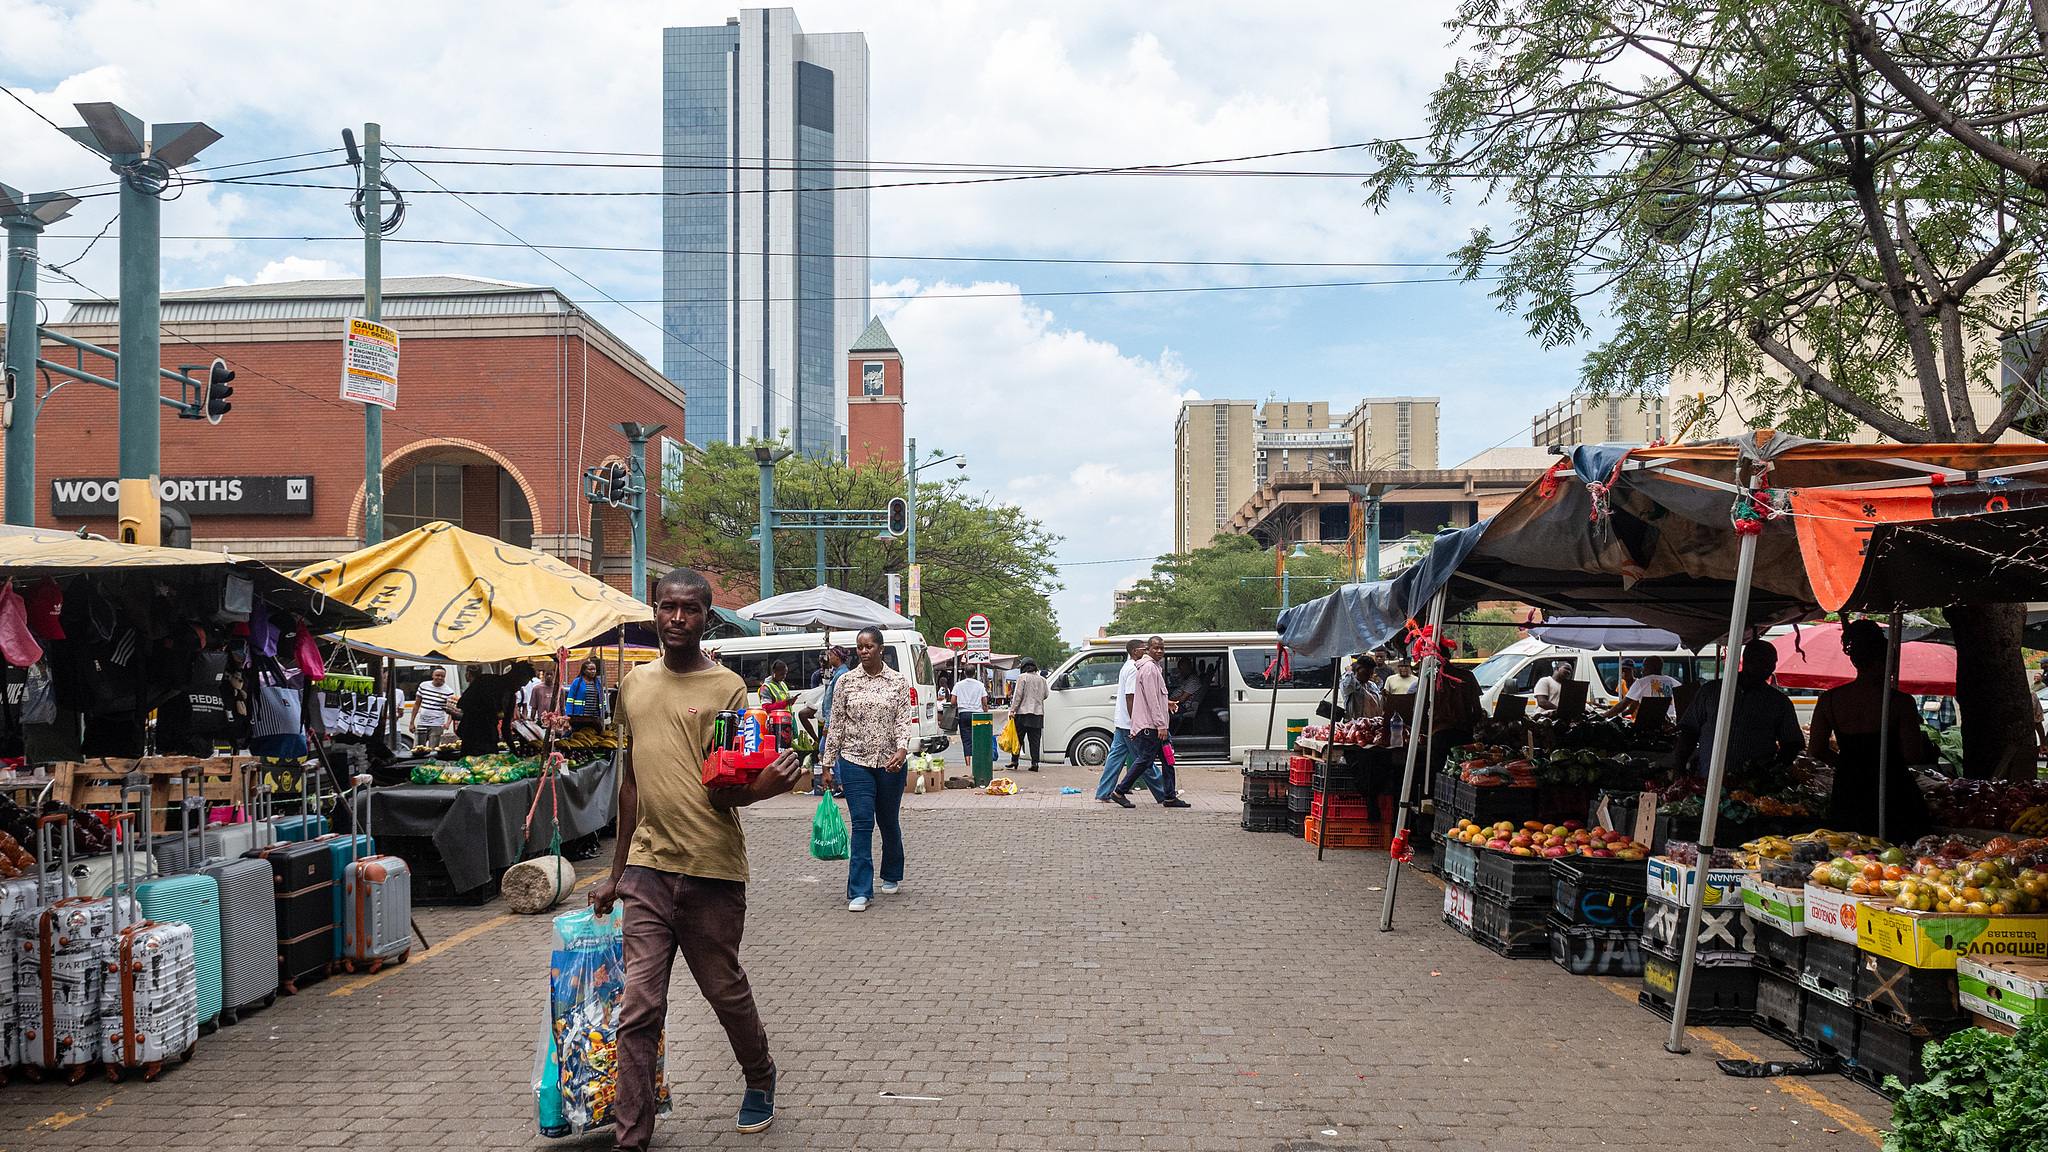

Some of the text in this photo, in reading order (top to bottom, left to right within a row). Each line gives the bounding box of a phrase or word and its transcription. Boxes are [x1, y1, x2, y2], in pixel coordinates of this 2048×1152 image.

[354, 320, 395, 338] GAUTENG
[371, 331, 395, 343] COLLEGE
[353, 348, 388, 360] ENGINEERING
[353, 353, 378, 361] BUSINESS
[54, 479, 243, 502] WOOORTHS
[291, 484, 303, 495] W
[366, 585, 402, 612] TN
[447, 597, 484, 631] MTN
[188, 694, 225, 706] REDBA
[743, 715, 756, 757] FANTA
[1706, 872, 1741, 883] BANAN
[1987, 930, 2038, 941] bananas
[58, 960, 91, 971] PARIS
